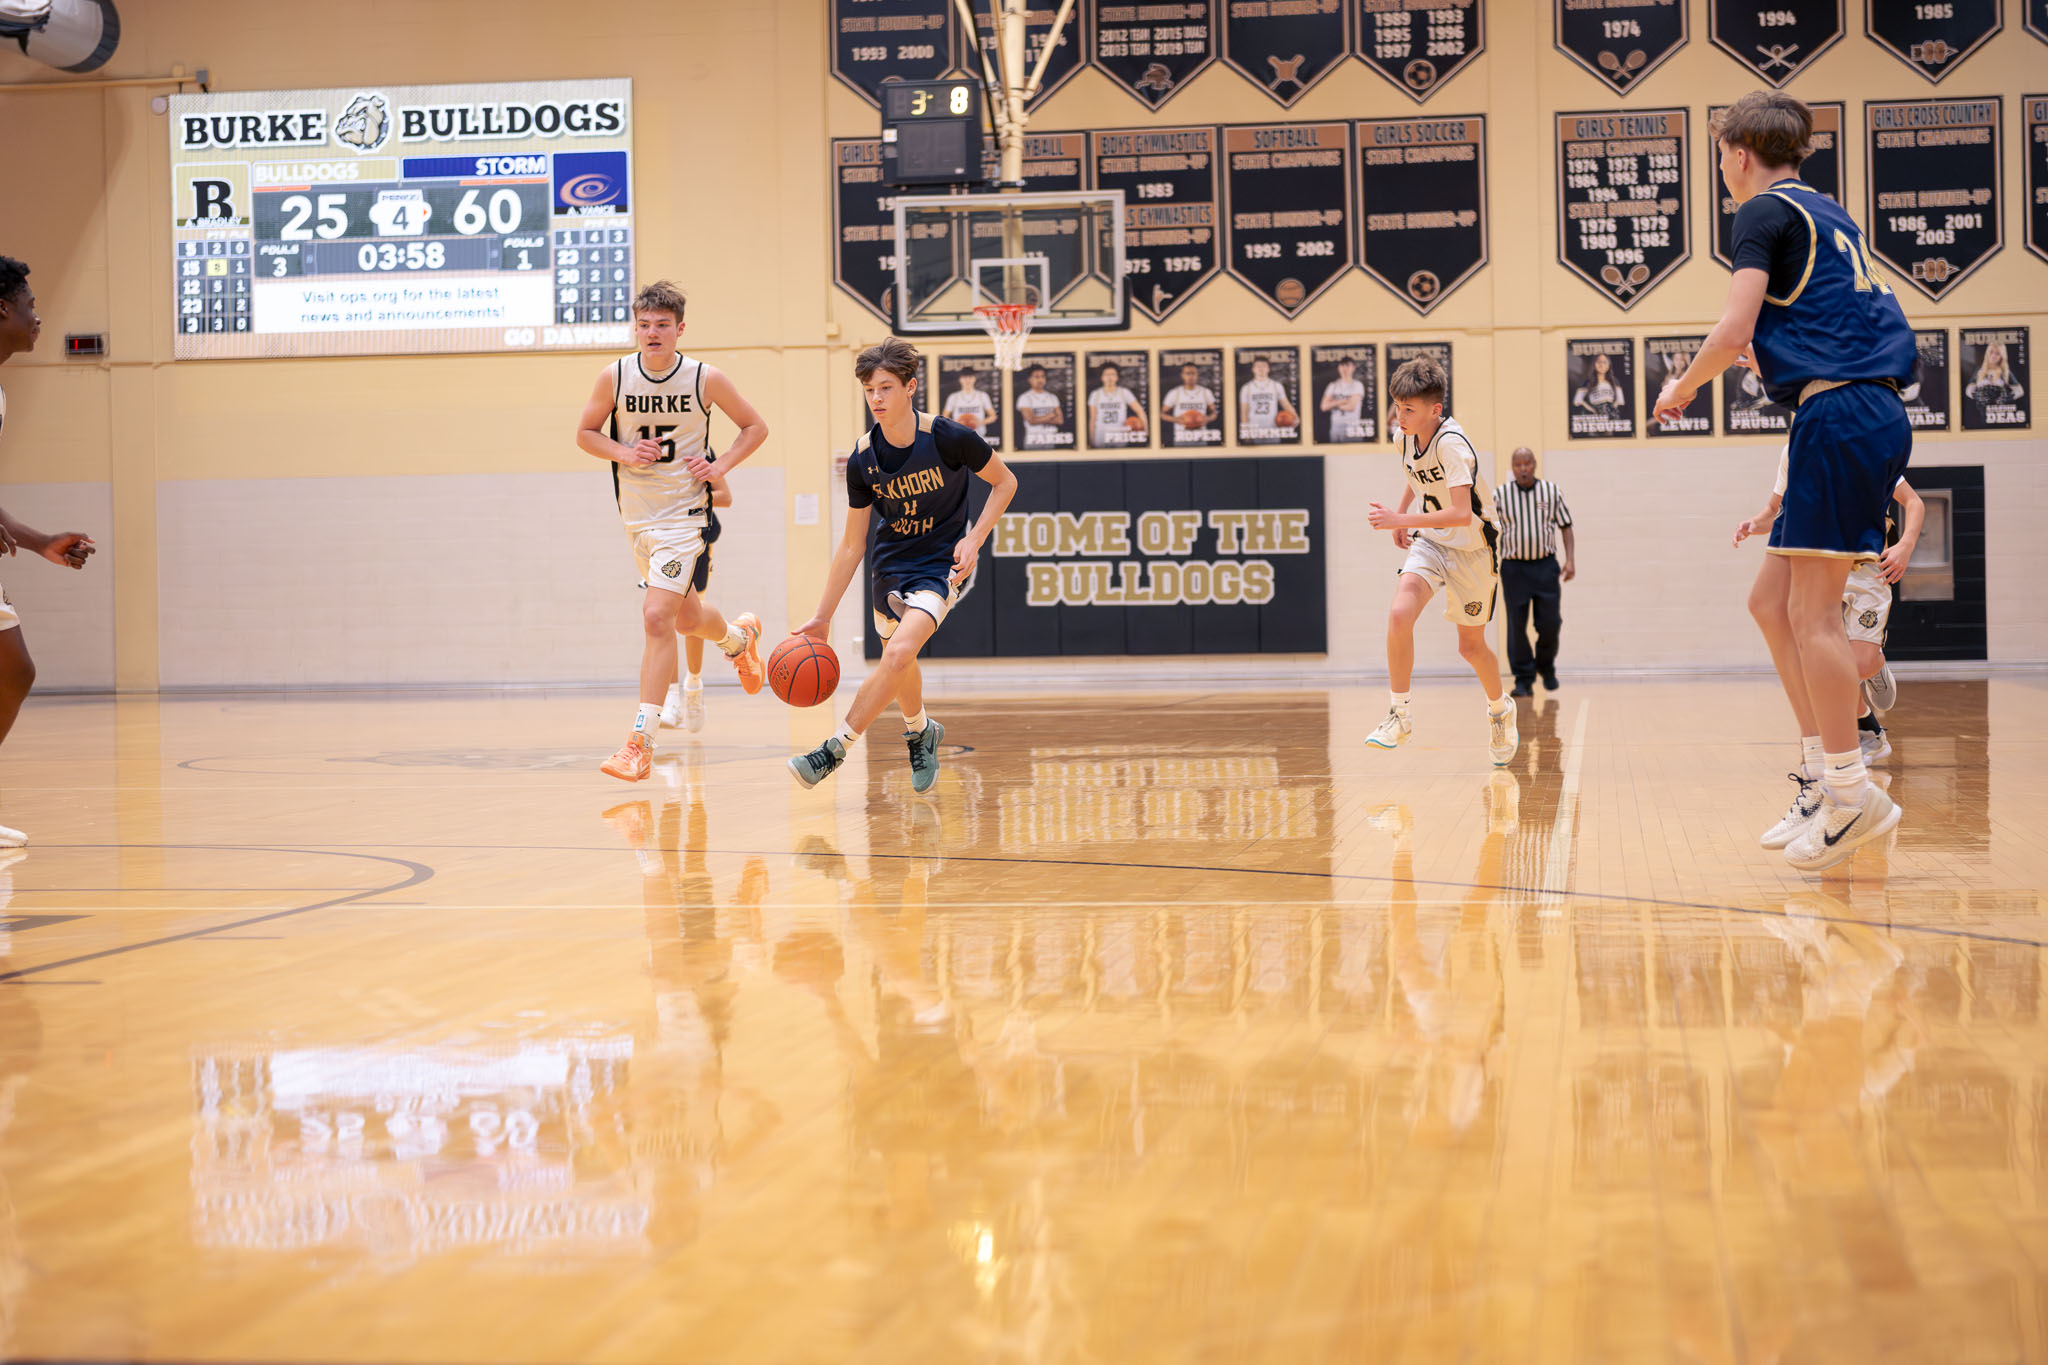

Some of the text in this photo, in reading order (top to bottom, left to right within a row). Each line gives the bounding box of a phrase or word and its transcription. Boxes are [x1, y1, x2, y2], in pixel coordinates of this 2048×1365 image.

[1427, 9, 1464, 24] 1993
[1757, 10, 1796, 27] 1994
[1914, 4, 1954, 20] 1985
[1374, 27, 1411, 42] 1995
[1603, 19, 1642, 38] 1974
[851, 46, 887, 61] 1993
[1374, 43, 1411, 58] 1997
[183, 101, 621, 146] BURKE BULLDOGS
[1874, 103, 1993, 128] GIRLS CROSS COUNTRY
[1375, 122, 1465, 144] GIRLS SOCCER
[1576, 116, 1668, 138] GIRLS TENNIS
[1102, 132, 1208, 154] BOYS GYMNASTICS
[1254, 128, 1319, 149] SOFTBALL
[1877, 132, 1916, 149] STATE
[255, 162, 359, 182] BULLDOGS
[476, 155, 546, 176] STORM
[1567, 158, 1599, 173] 1974
[1607, 157, 1639, 171] 1975
[1136, 183, 1174, 198] 1983
[1628, 185, 1660, 200] 1997
[192, 180, 234, 222] B
[1878, 191, 1917, 209] STATE
[280, 194, 349, 241] 25
[392, 206, 409, 230] 4
[453, 188, 523, 235] 60
[1139, 206, 1211, 226] GYMNASTICS
[1568, 202, 1606, 219] STATE
[1580, 216, 1669, 234] 1976 1979
[1888, 213, 1983, 232] 1986 2001
[563, 230, 573, 246] 1
[614, 230, 624, 242] 3
[1580, 232, 1670, 250] 1980 1982
[1916, 229, 1955, 246] 2003
[212, 242, 222, 255] 2
[235, 241, 245, 254] 0
[357, 242, 446, 270] 03:58
[1244, 240, 1334, 259] 1992 2002
[516, 250, 532, 270] 1
[557, 249, 624, 266] 23 4 3
[1125, 256, 1202, 274] 975 1976
[1606, 249, 1644, 265] 1996
[236, 260, 245, 273] 1
[272, 257, 287, 277] 3
[590, 270, 600, 282] 2
[614, 268, 624, 281] 0
[182, 280, 201, 295] 12
[236, 280, 245, 292] 1
[303, 291, 335, 303] Visit
[403, 289, 423, 301] for
[429, 288, 451, 300] the
[457, 287, 500, 299] latest
[590, 288, 601, 301] 2
[615, 288, 624, 301] 1
[182, 298, 246, 314] 23 4 2
[301, 312, 340, 323] news
[345, 310, 372, 322] and
[563, 307, 625, 323] 4 1 0
[186, 317, 246, 333] 3 3 0
[624, 394, 692, 414] BURKE
[1660, 418, 1709, 431] LEWIS
[1730, 416, 1787, 429] PRUSIA
[1985, 410, 2026, 424] DEAS
[1572, 420, 1632, 432] DIEGUEZ
[1025, 433, 1074, 445] PARKS
[1104, 431, 1148, 443] PRICE
[890, 516, 934, 536] OUTH
[993, 509, 1309, 557] HOME OF THE
[1026, 560, 1275, 606] BULLDOGS
